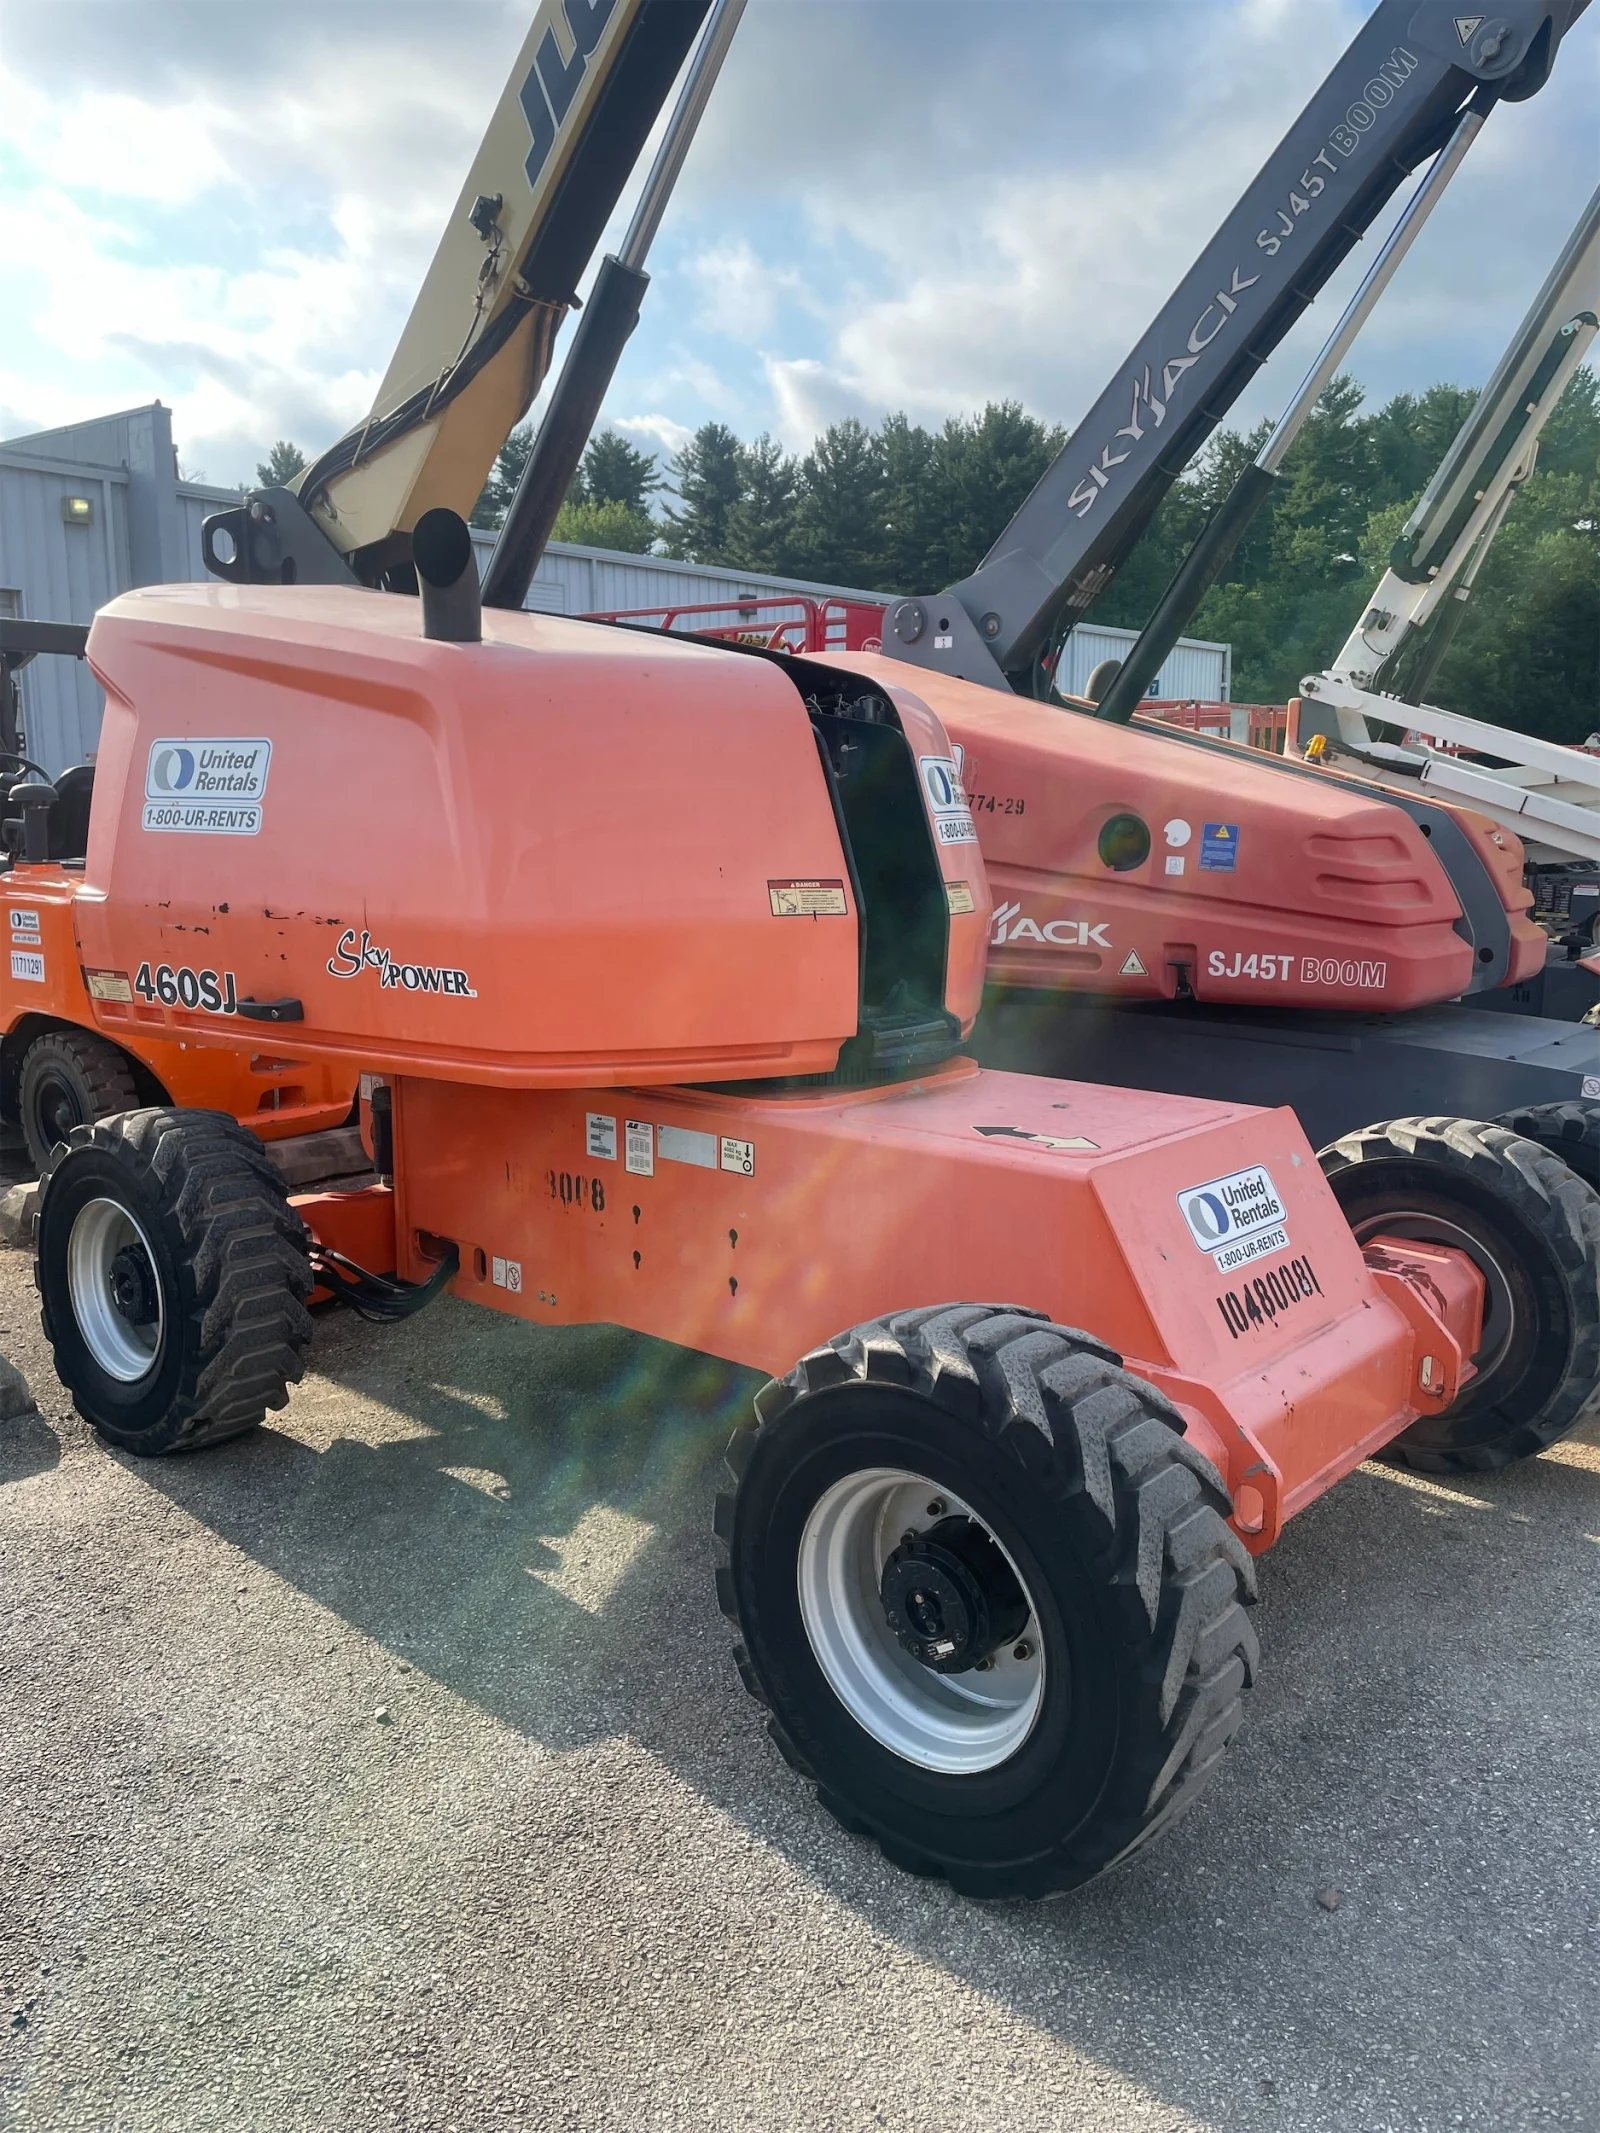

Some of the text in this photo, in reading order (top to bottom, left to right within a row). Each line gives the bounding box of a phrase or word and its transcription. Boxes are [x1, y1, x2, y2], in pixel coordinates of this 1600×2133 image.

[1066, 46, 1420, 519] SKYJACK SJ45T BOOM
[199, 749, 258, 769] United
[194, 771, 259, 792] Rentals
[145, 808, 257, 829] 1-800-UR-RENTS
[12, 956, 42, 976] 11711291
[1207, 950, 1387, 989] SJ45T BOOM
[134, 962, 237, 1016] 460SJ
[1220, 1174, 1266, 1208] United
[1230, 1196, 1280, 1230] Rentals
[1216, 1229, 1286, 1269] 1-800-UR-RENTS
[1215, 1254, 1322, 1340] 10480081
